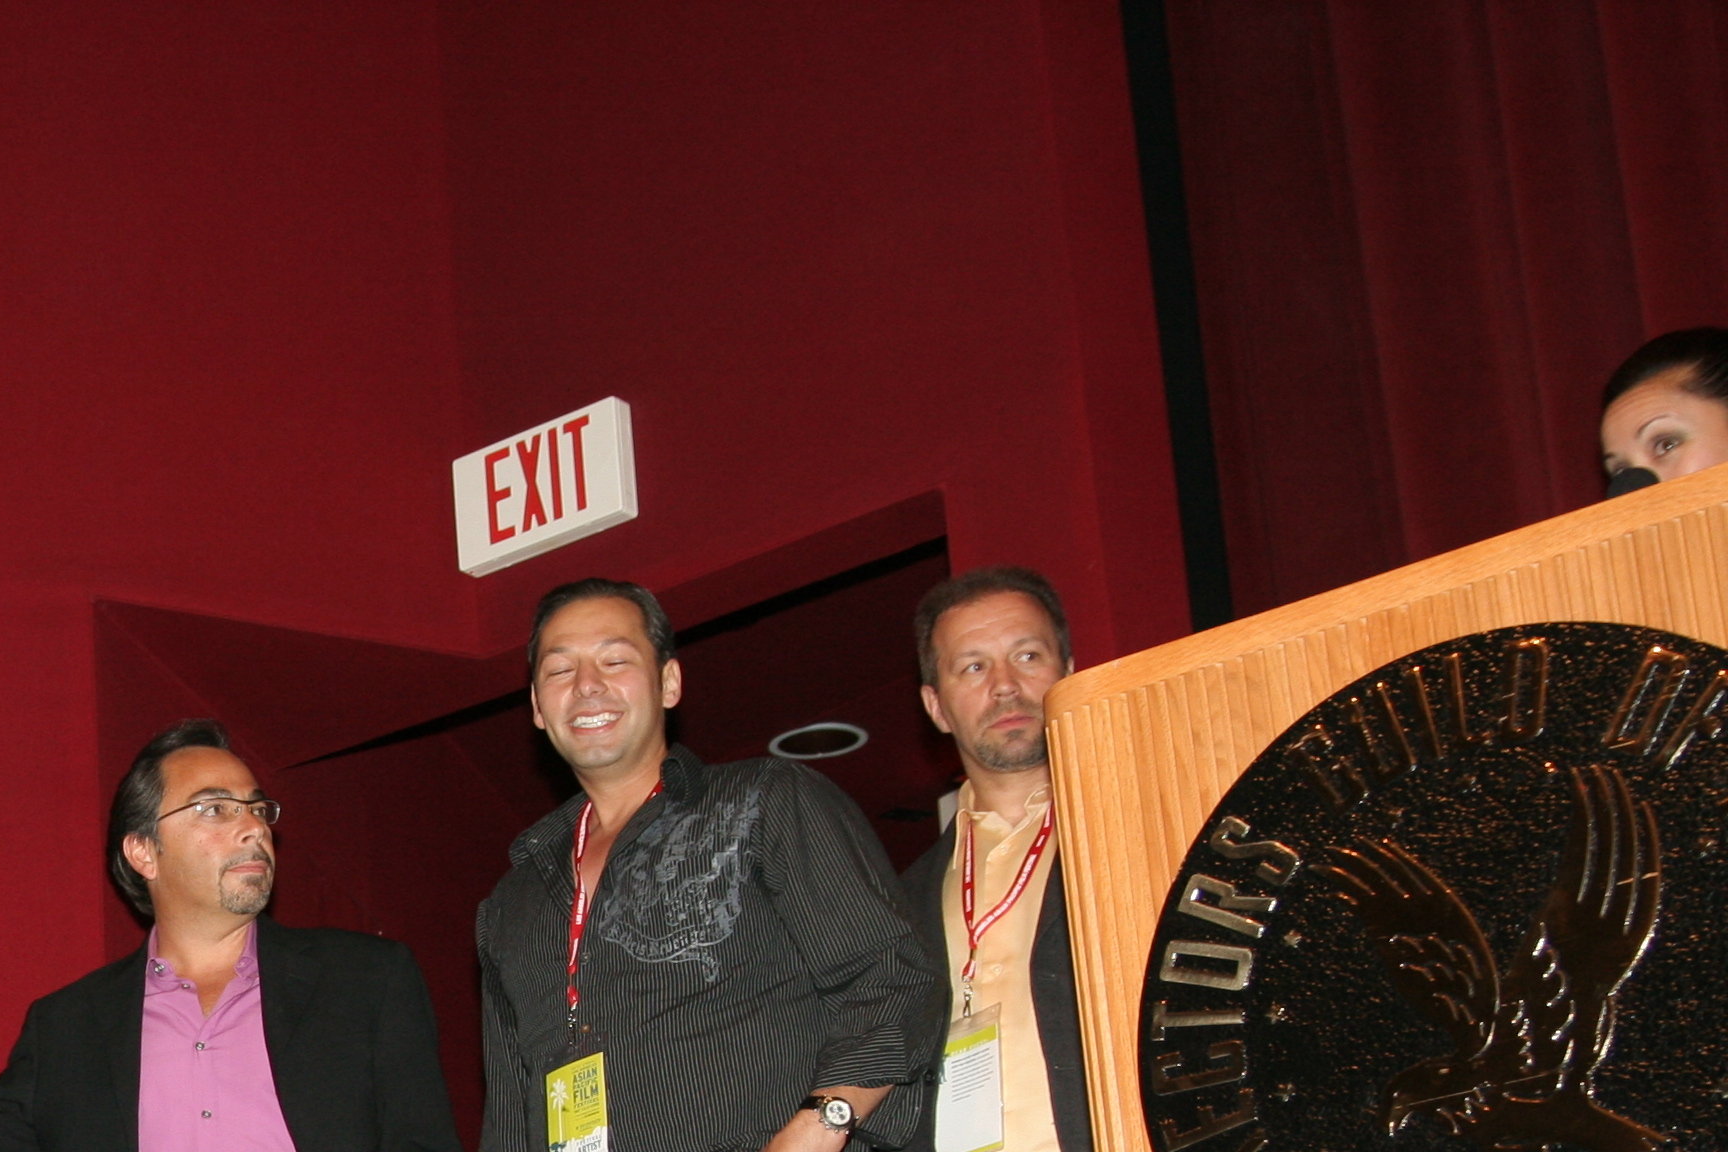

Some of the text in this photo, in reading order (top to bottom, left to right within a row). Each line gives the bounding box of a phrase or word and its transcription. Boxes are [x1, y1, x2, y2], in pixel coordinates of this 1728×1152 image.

[485, 413, 590, 545] EXIT
[572, 1066, 598, 1084] ASIAN
[573, 1083, 599, 1104] FILM
